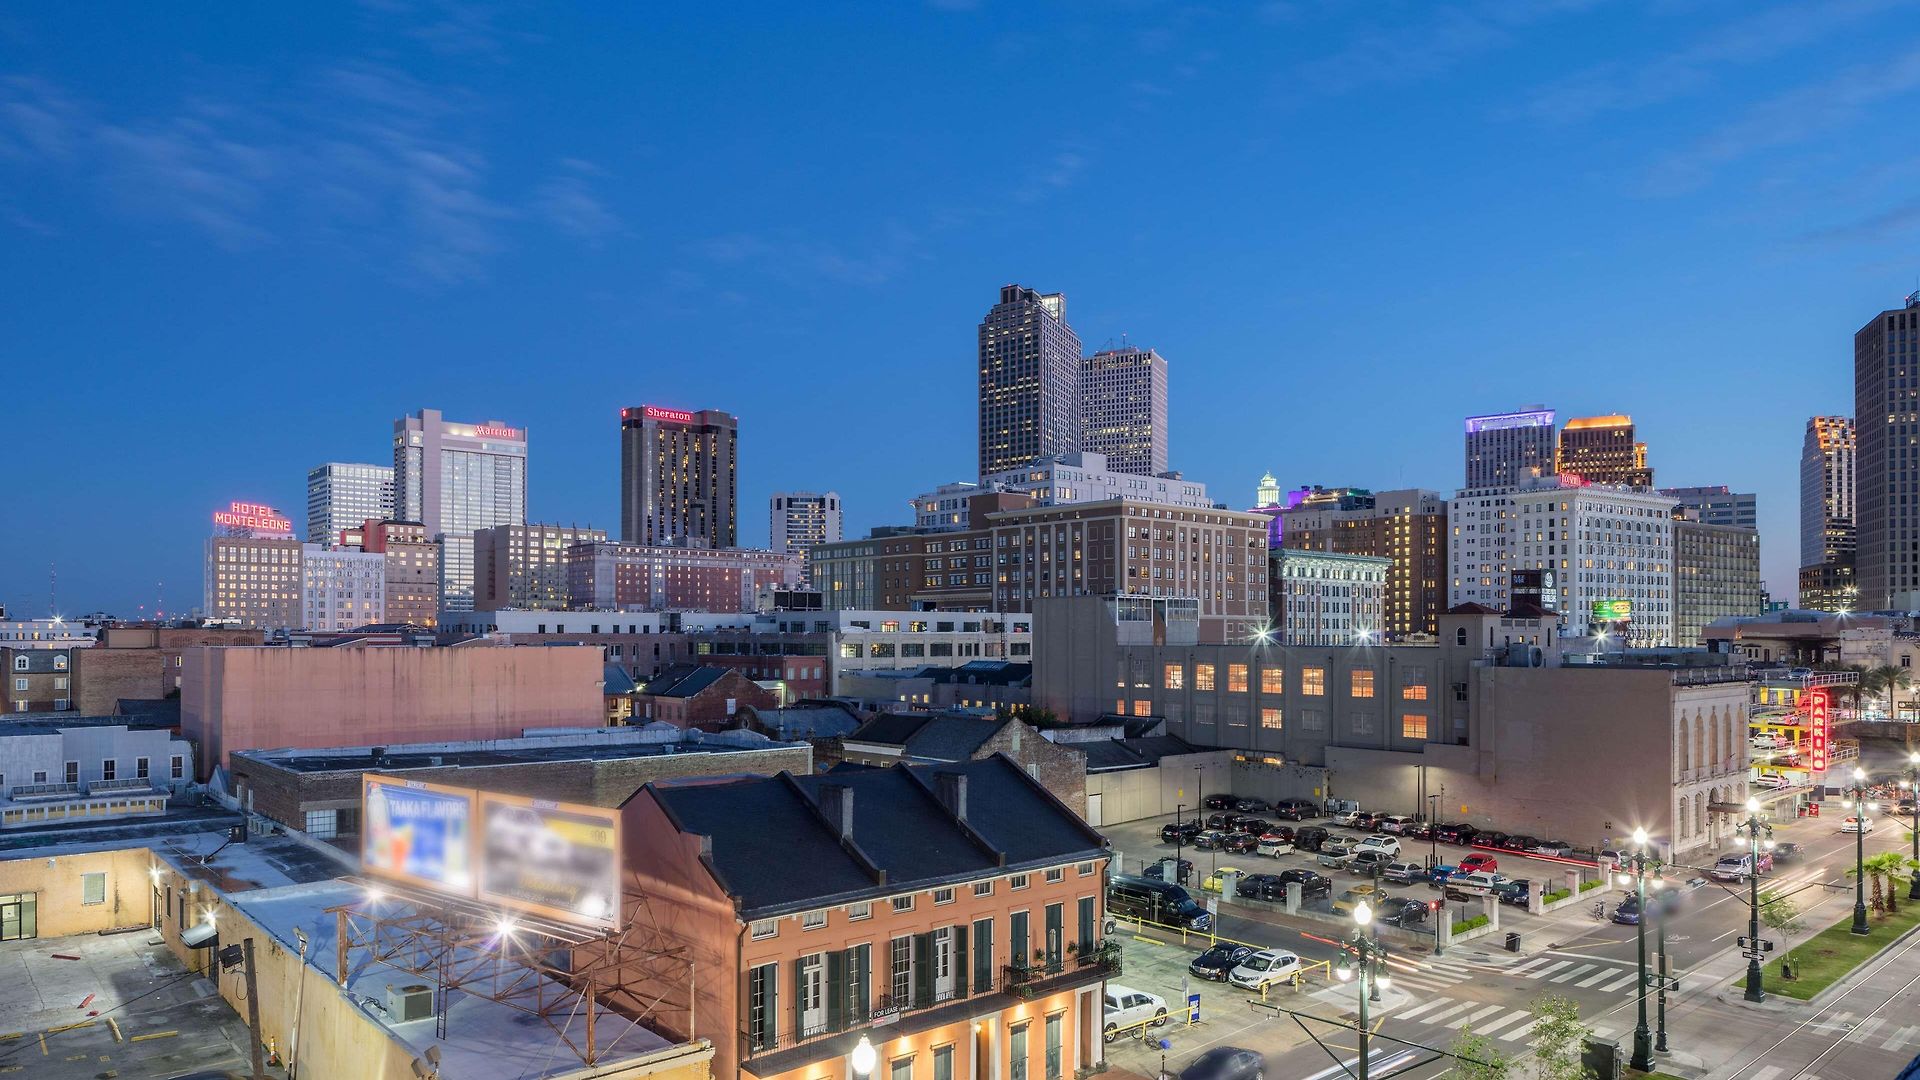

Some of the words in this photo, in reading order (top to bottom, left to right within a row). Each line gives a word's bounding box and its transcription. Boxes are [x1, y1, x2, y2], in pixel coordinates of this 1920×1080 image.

[647, 407, 691, 420] Sheraton
[475, 425, 515, 437] Marriott
[232, 502, 274, 517] HOTEL
[215, 512, 291, 531] MONTELEONE
[1813, 696, 1824, 769] PARKING
[874, 1010, 884, 1018] FOR
[885, 1005, 899, 1015] LEASE
